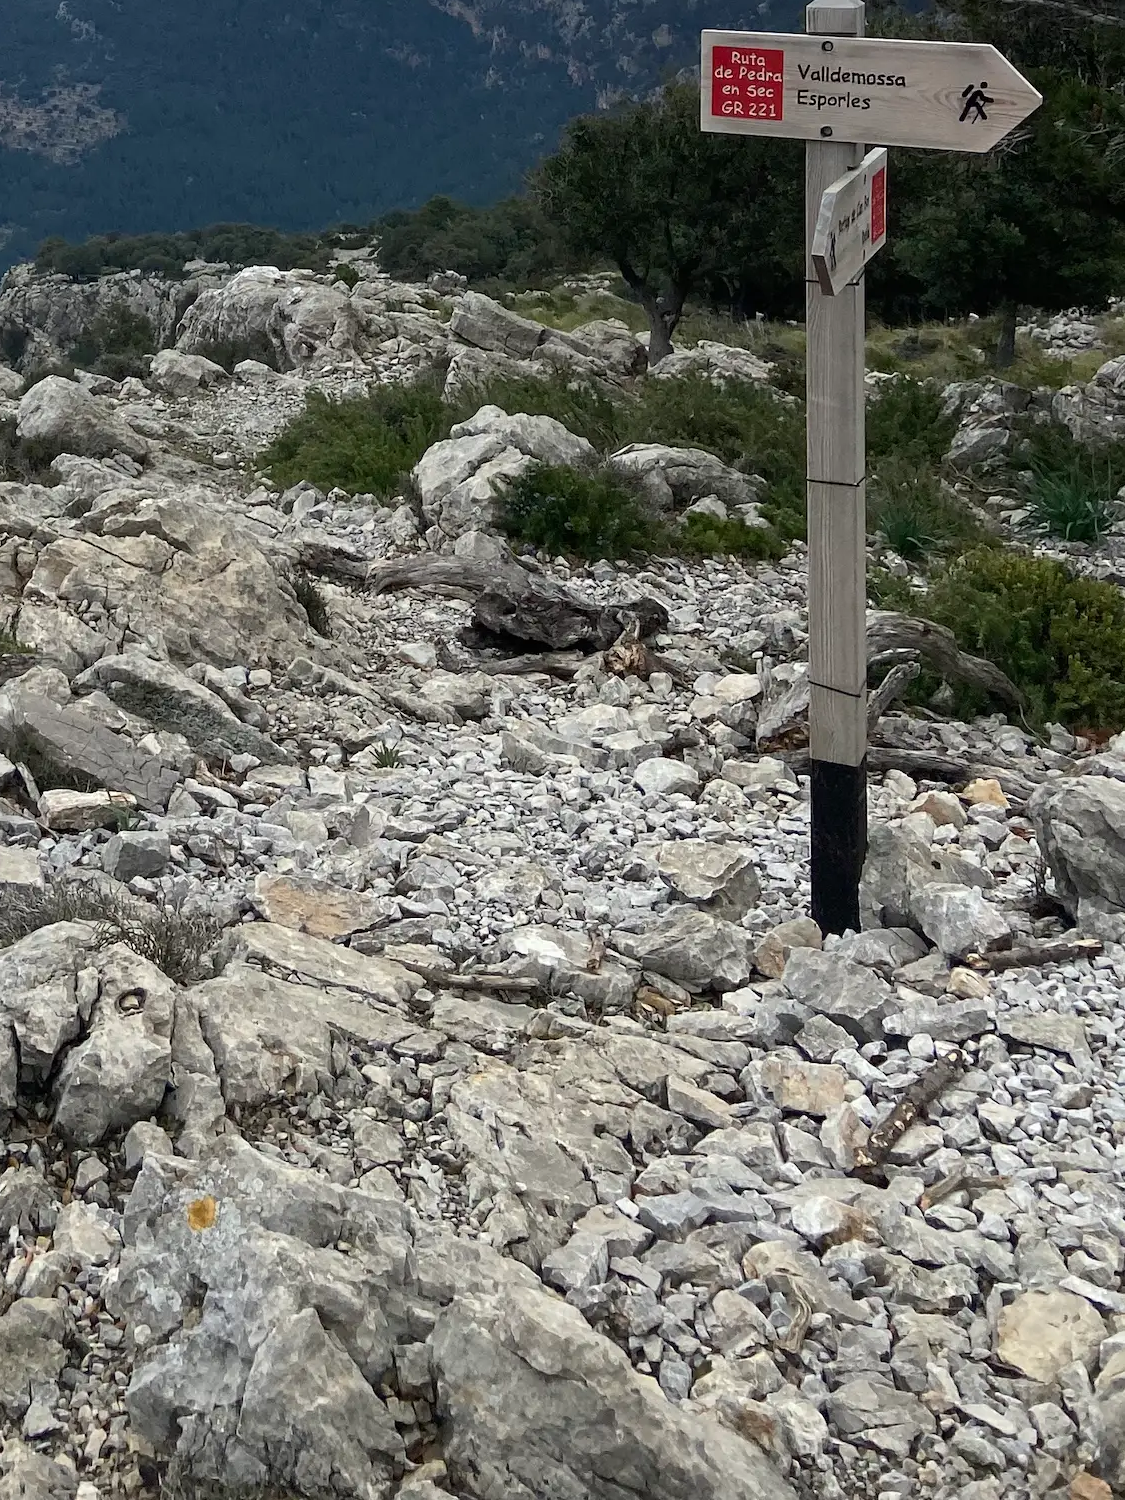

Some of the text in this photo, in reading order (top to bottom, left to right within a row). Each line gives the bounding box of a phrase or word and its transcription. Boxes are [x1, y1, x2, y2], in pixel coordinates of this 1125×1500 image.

[731, 51, 766, 66] Ruta
[714, 65, 783, 83] de Pedra
[797, 64, 906, 87] Valldemossa
[721, 84, 774, 98] en Sec
[796, 89, 871, 111] Esporles
[721, 101, 776, 117] GR 221
